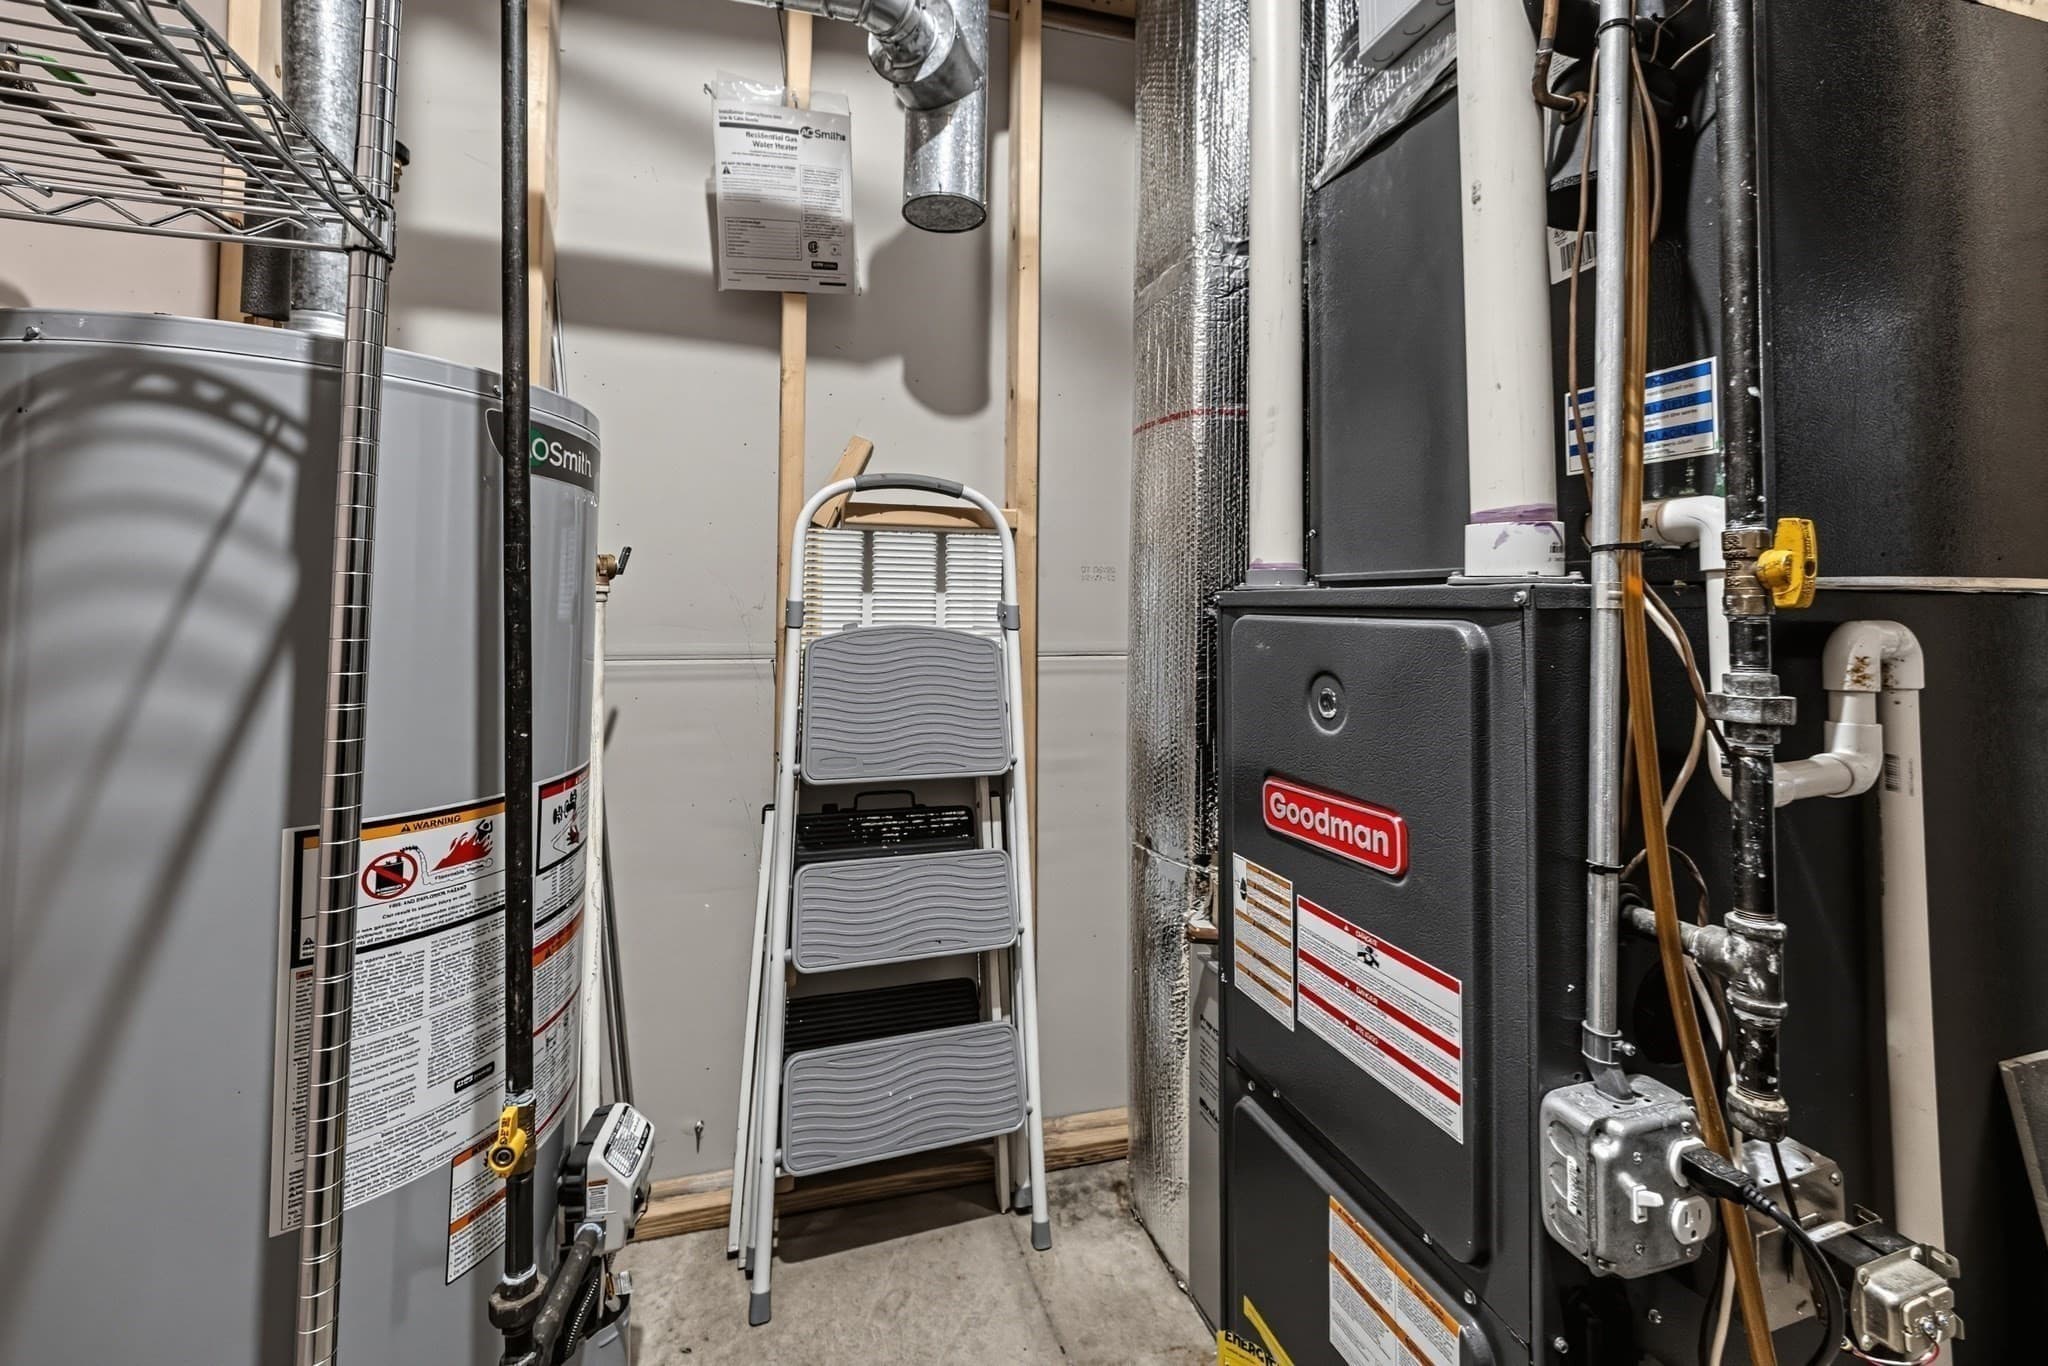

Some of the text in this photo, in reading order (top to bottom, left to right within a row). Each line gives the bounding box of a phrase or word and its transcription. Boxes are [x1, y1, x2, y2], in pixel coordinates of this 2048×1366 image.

[745, 131, 783, 141] Residential
[752, 140, 798, 151] Water Heater
[532, 438, 592, 478] OSmith
[413, 815, 461, 831] WARNING
[1270, 792, 1389, 857] Goodman
[1355, 930, 1378, 947] DANGER
